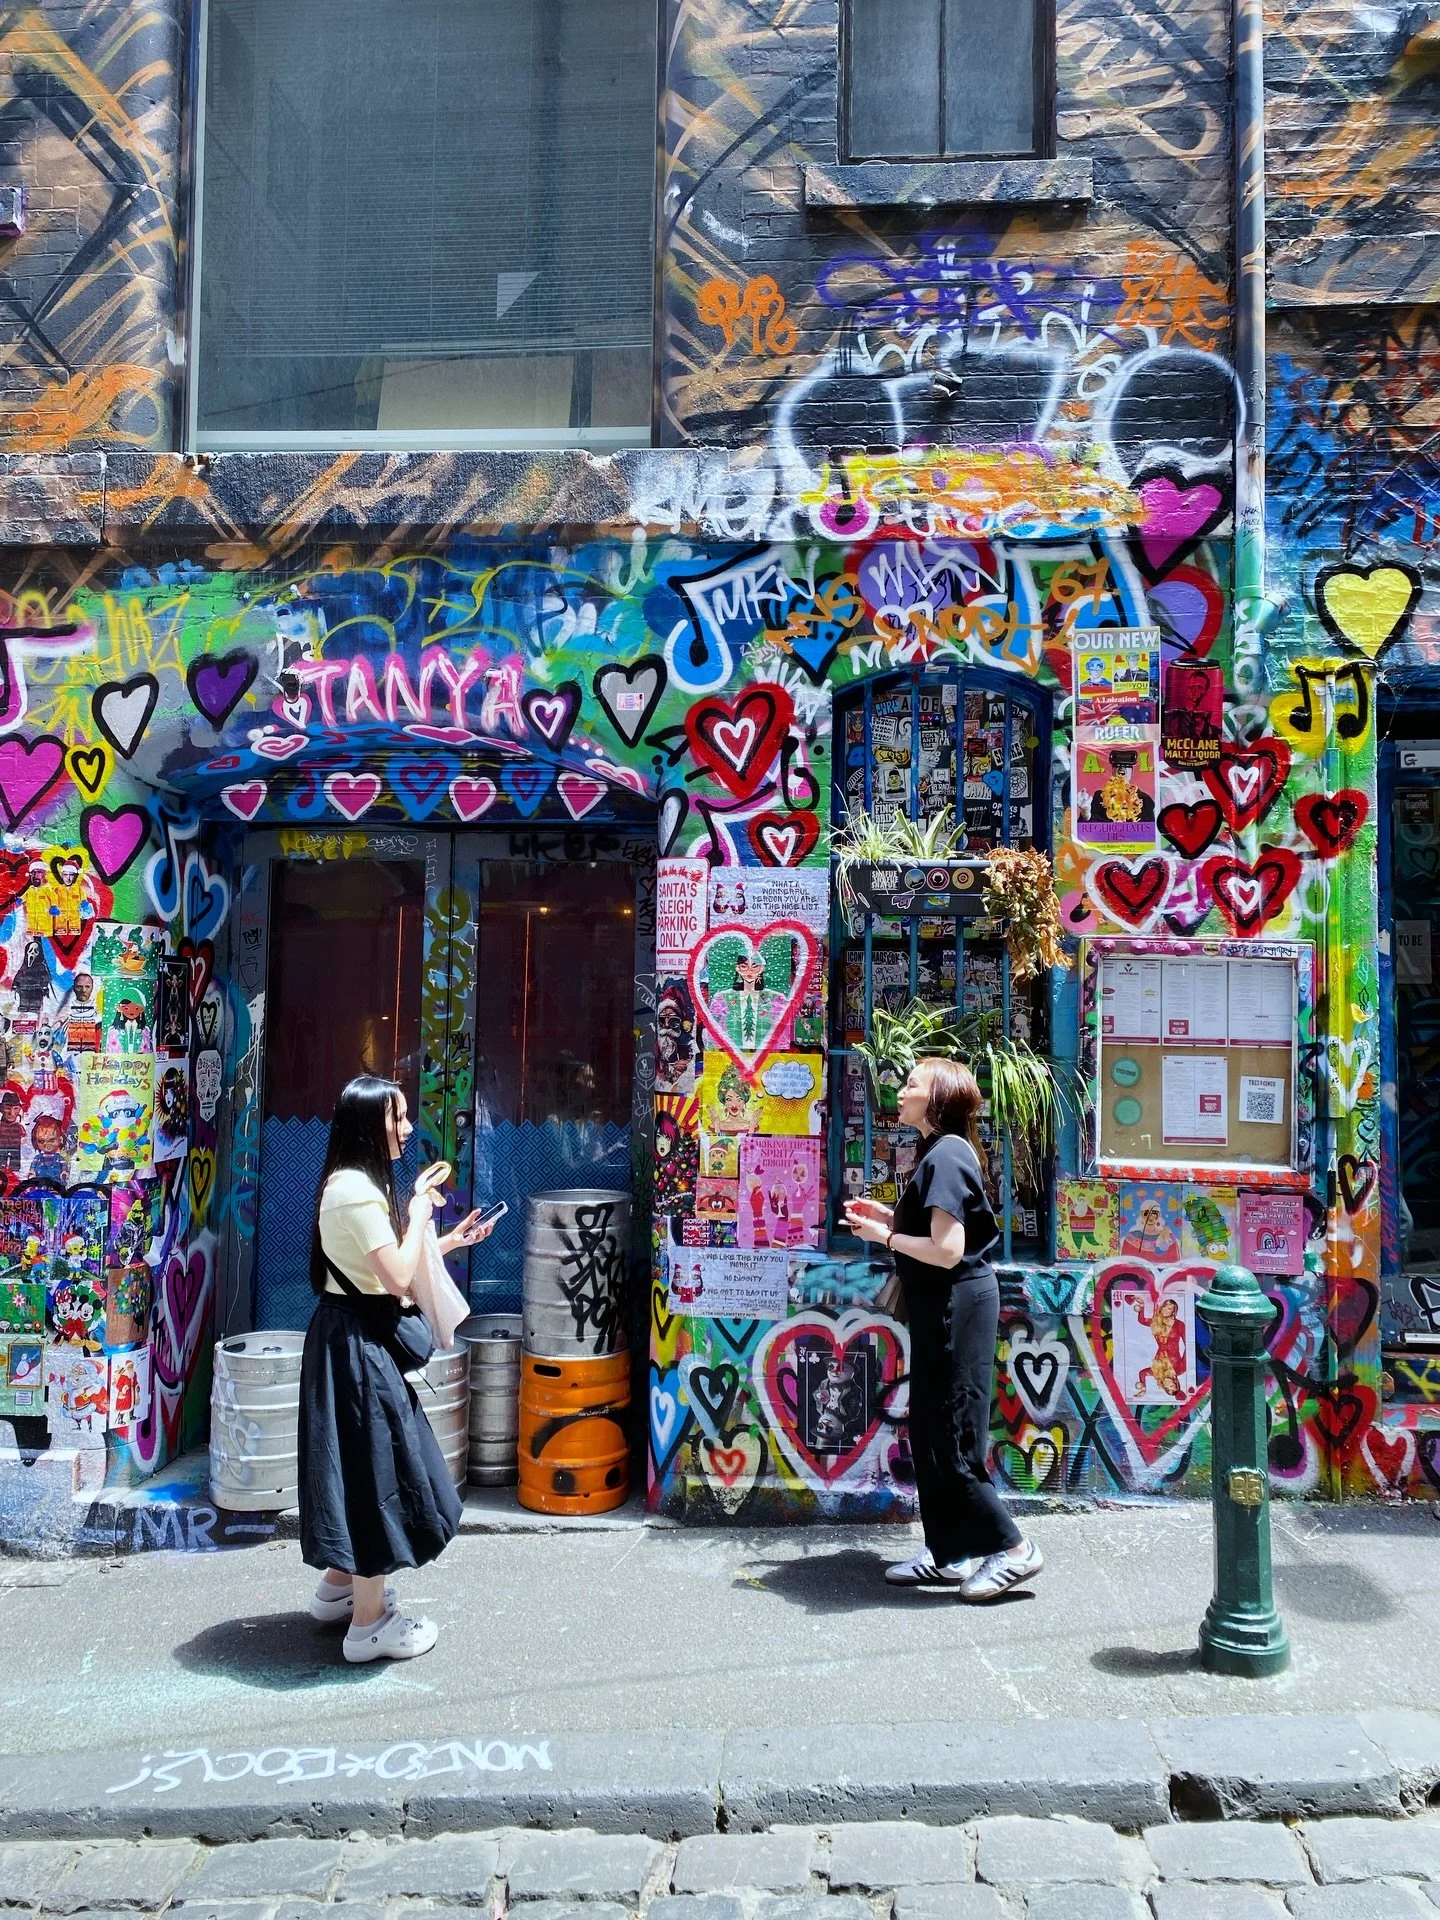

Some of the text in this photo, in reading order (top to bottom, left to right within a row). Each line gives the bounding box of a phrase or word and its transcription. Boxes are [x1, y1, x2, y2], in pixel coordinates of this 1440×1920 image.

[1074, 631, 1158, 649] OUR NEW
[294, 645, 528, 735] TANYA
[1165, 750, 1220, 760] MALT LIQUOR
[1082, 823, 1150, 833] REGURGITATES
[1107, 832, 1125, 841] LIES
[659, 883, 697, 897] SANTA'S
[801, 895, 817, 903] ARE
[660, 900, 693, 914] SLEIGH
[658, 916, 697, 931] PARKING
[661, 933, 688, 947] ONLY
[1411, 935, 1422, 946] BE
[90, 1056, 150, 1076] Happy
[87, 1073, 150, 1090] Holidays
[761, 1149, 794, 1158] SPRITZ
